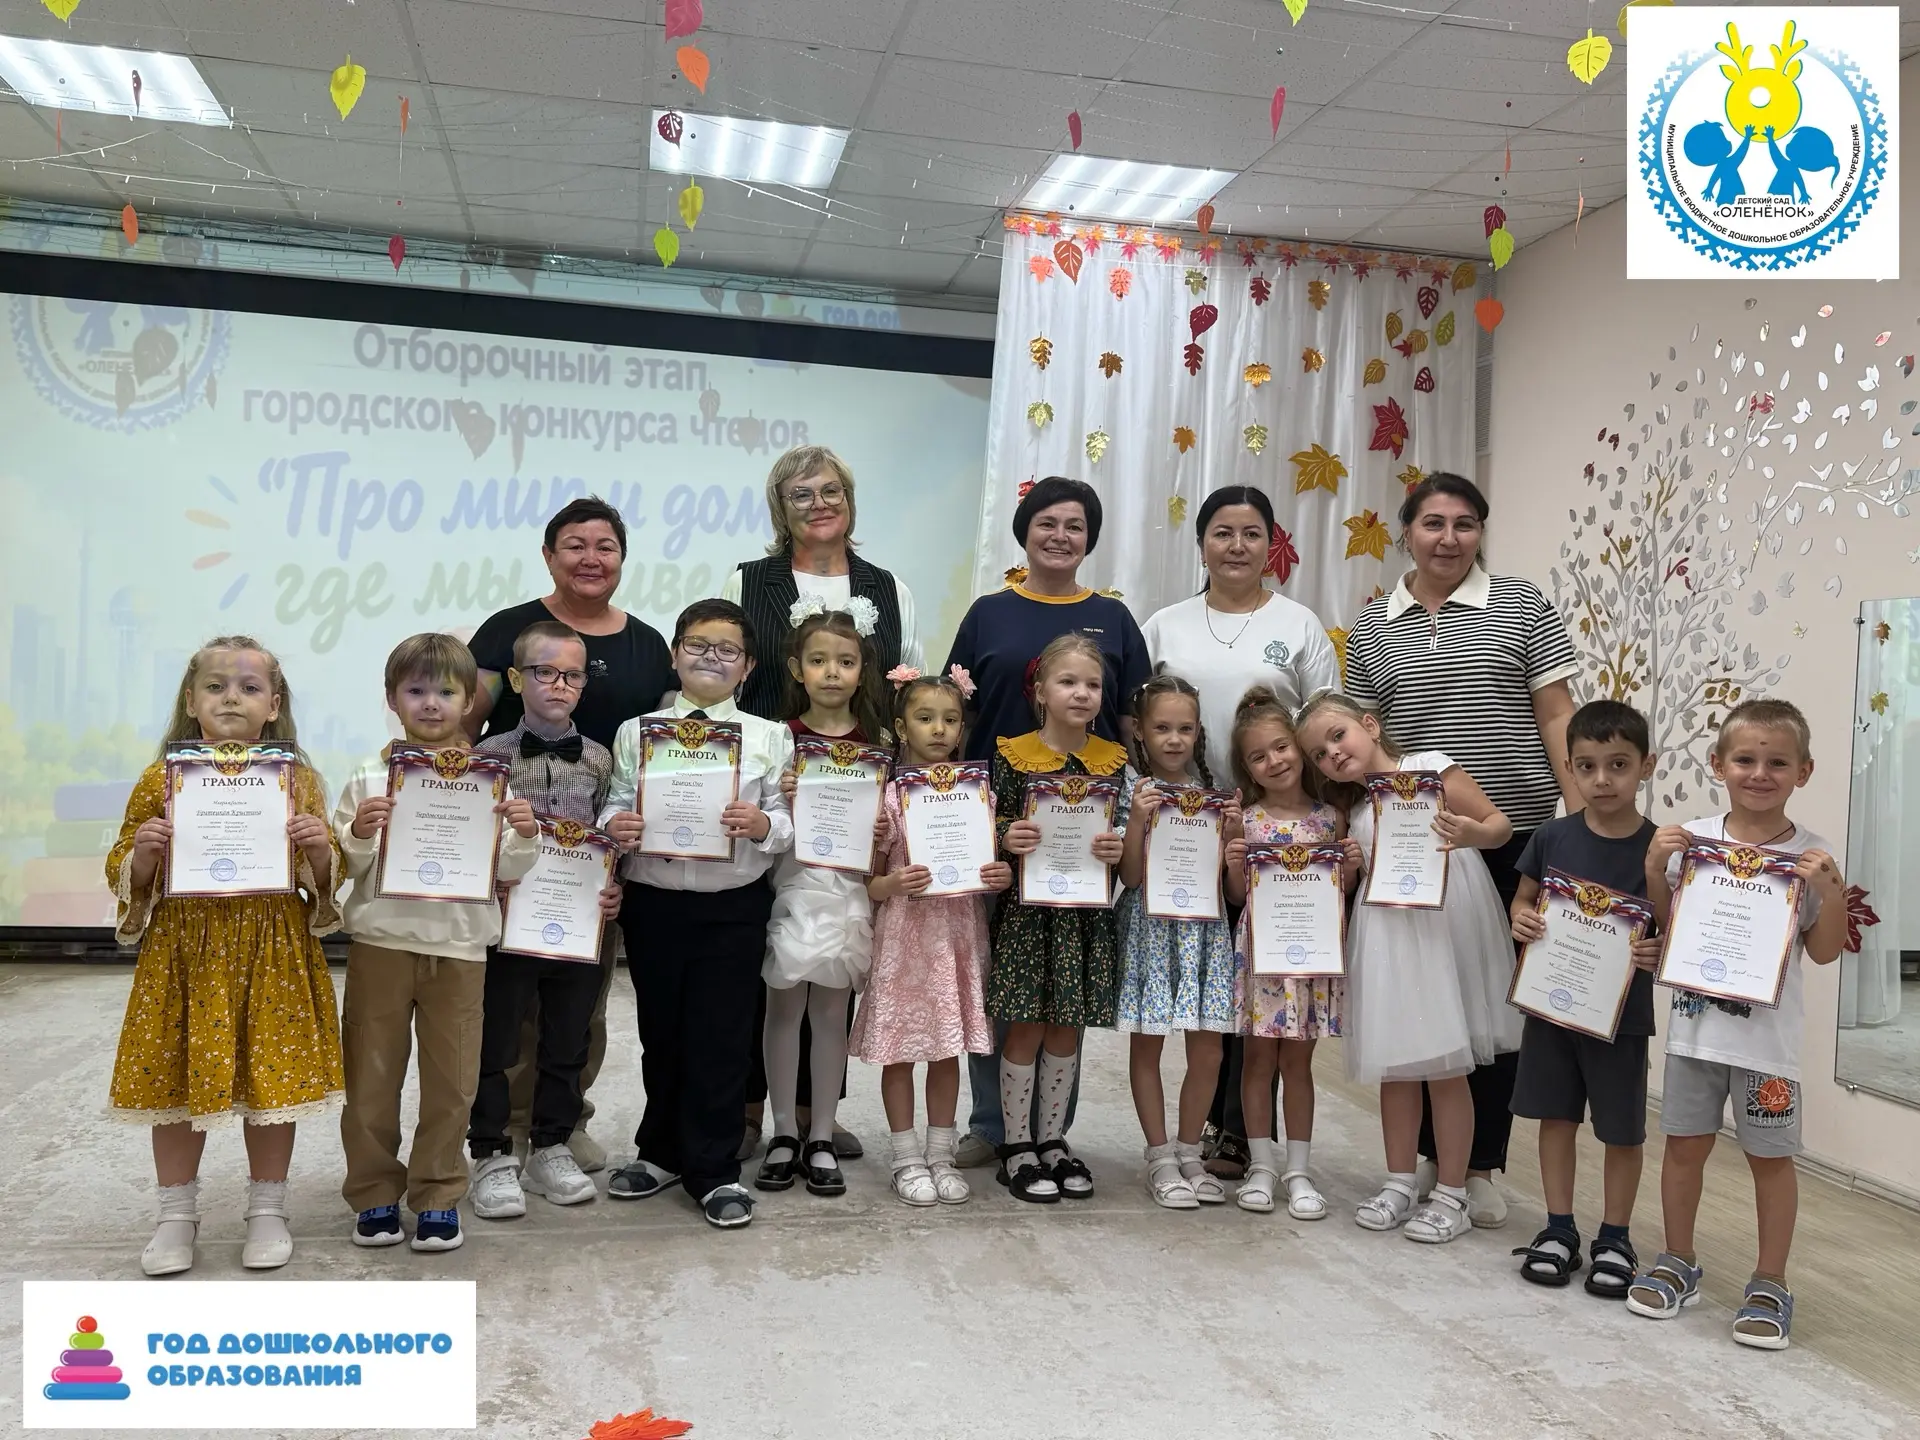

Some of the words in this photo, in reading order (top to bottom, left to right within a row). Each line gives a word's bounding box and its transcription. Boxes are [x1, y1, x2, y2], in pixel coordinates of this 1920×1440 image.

[354, 323, 611, 387] Отборочный
[624, 357, 707, 391] этап
[500, 402, 678, 451] конкурса
[276, 561, 393, 654] где
[413, 556, 529, 616] мы
[668, 749, 718, 760] ГРАМОТА
[820, 765, 866, 778] ГРАМОТА
[202, 777, 265, 787] ГРАМОТА
[421, 779, 480, 792] ГРАМОТА
[923, 792, 970, 803] ГРАМОТА
[1050, 805, 1095, 814] ГРАМОТА
[1392, 801, 1430, 811] ГРАМОТА
[1170, 817, 1208, 828] ГРАМОТА
[541, 845, 593, 861] ГРАМОТА
[1273, 873, 1321, 882] ГРАМОТА
[1711, 875, 1773, 895] ГРАМОТА
[1561, 908, 1617, 935] ГРАМОТА
